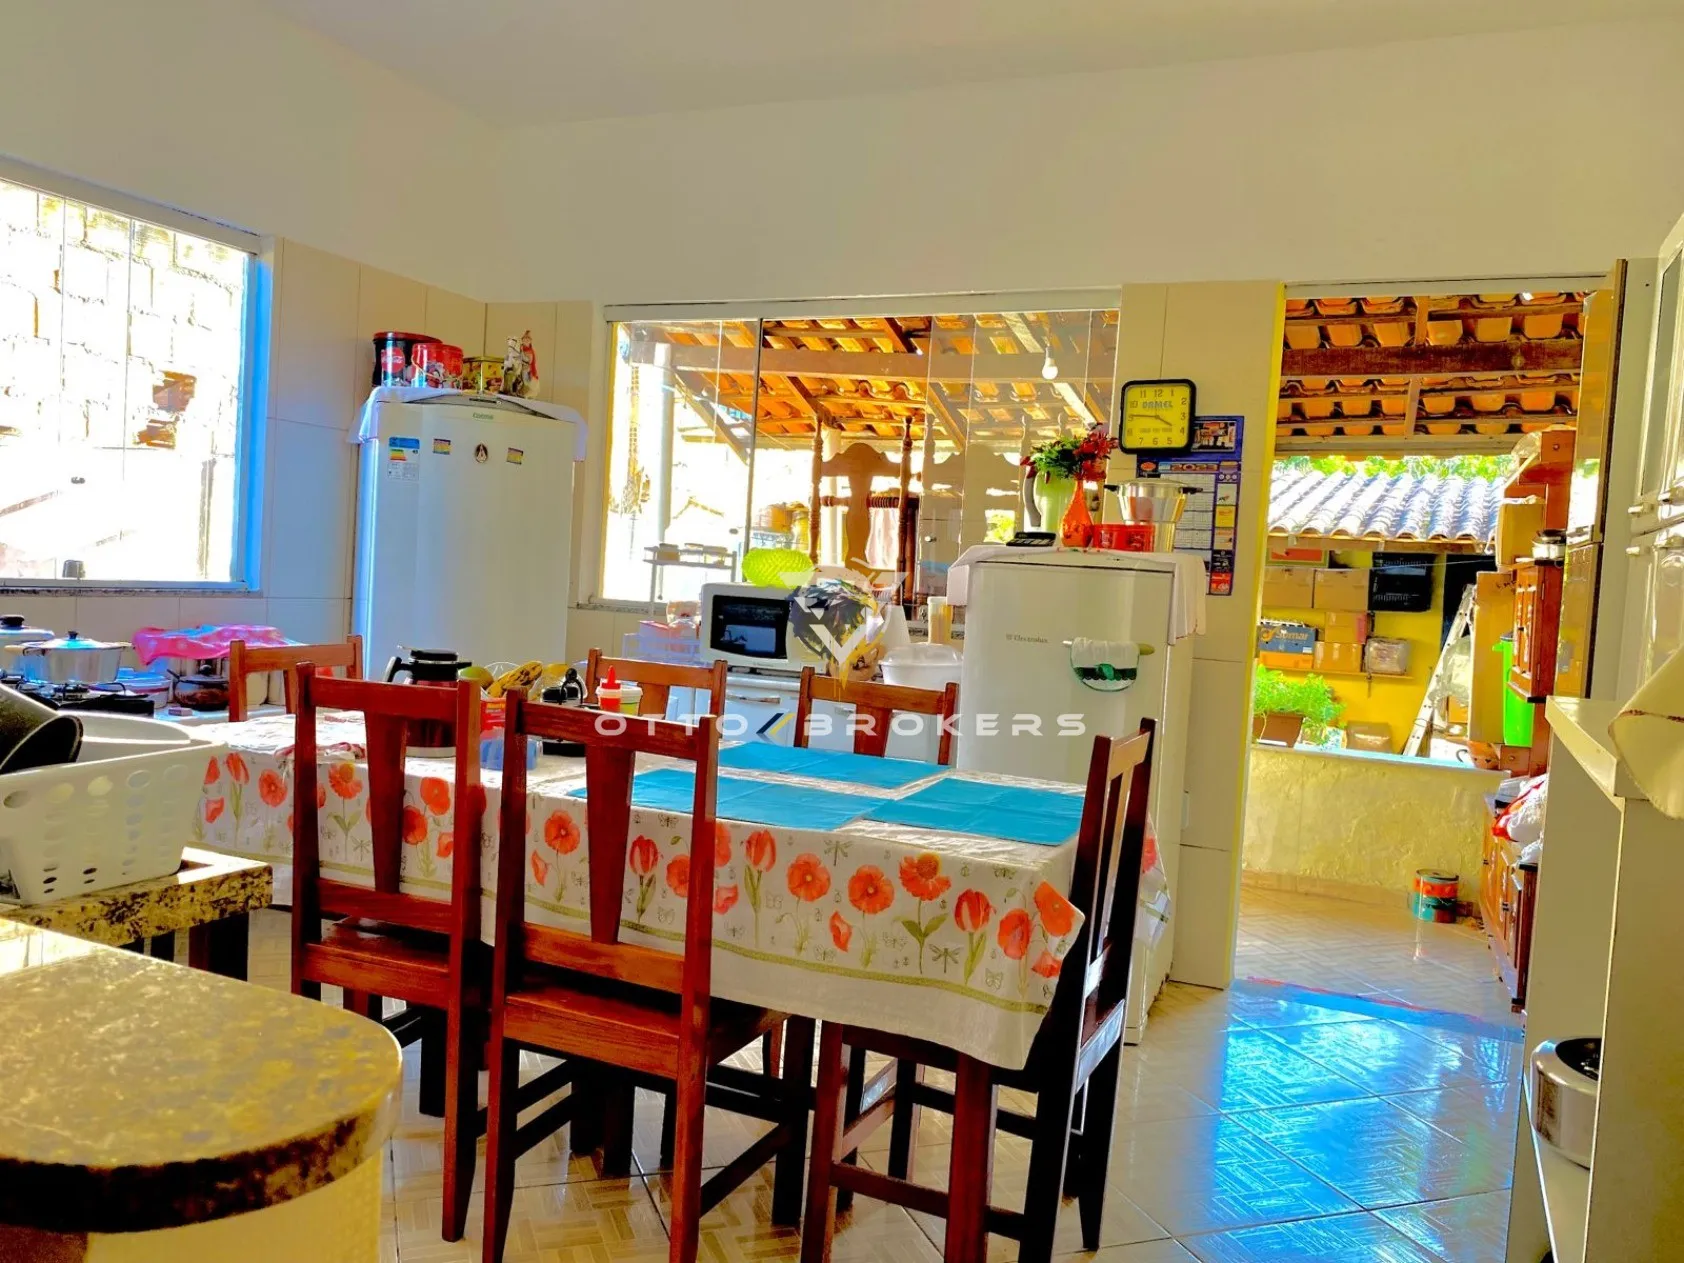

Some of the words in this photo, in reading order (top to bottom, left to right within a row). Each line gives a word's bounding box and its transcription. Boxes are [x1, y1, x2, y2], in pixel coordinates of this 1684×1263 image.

[1140, 389, 1147, 398] 11
[1154, 389, 1163, 398] 12
[1181, 397, 1188, 406] 2
[1181, 412, 1186, 421] 3
[1180, 427, 1185, 436] 4
[1153, 437, 1158, 446] 6
[1167, 437, 1173, 445] 5
